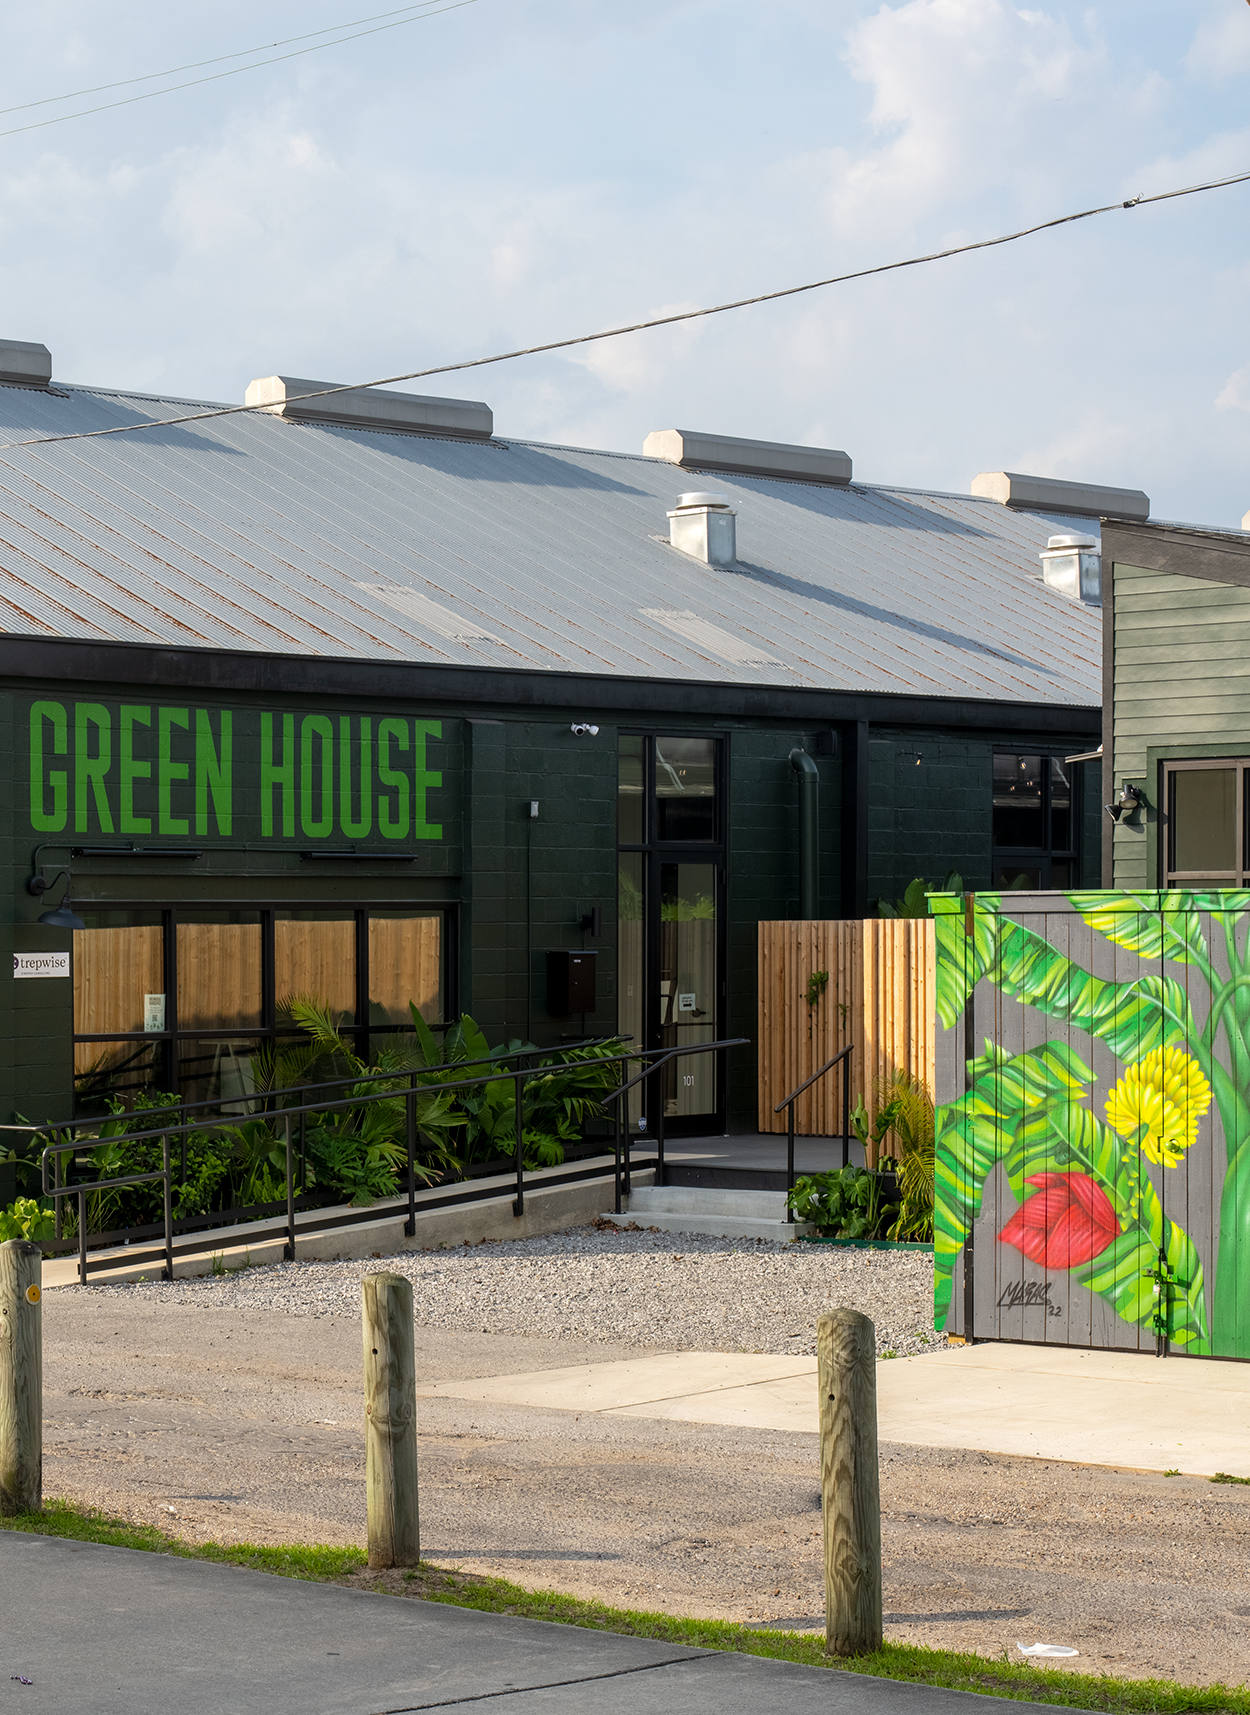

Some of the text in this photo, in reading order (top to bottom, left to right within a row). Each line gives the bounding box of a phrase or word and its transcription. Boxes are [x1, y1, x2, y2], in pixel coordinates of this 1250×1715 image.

[30, 700, 443, 840] GREEN HOUSE
[20, 956, 66, 971] trepwise
[683, 1075, 695, 1087] 101
